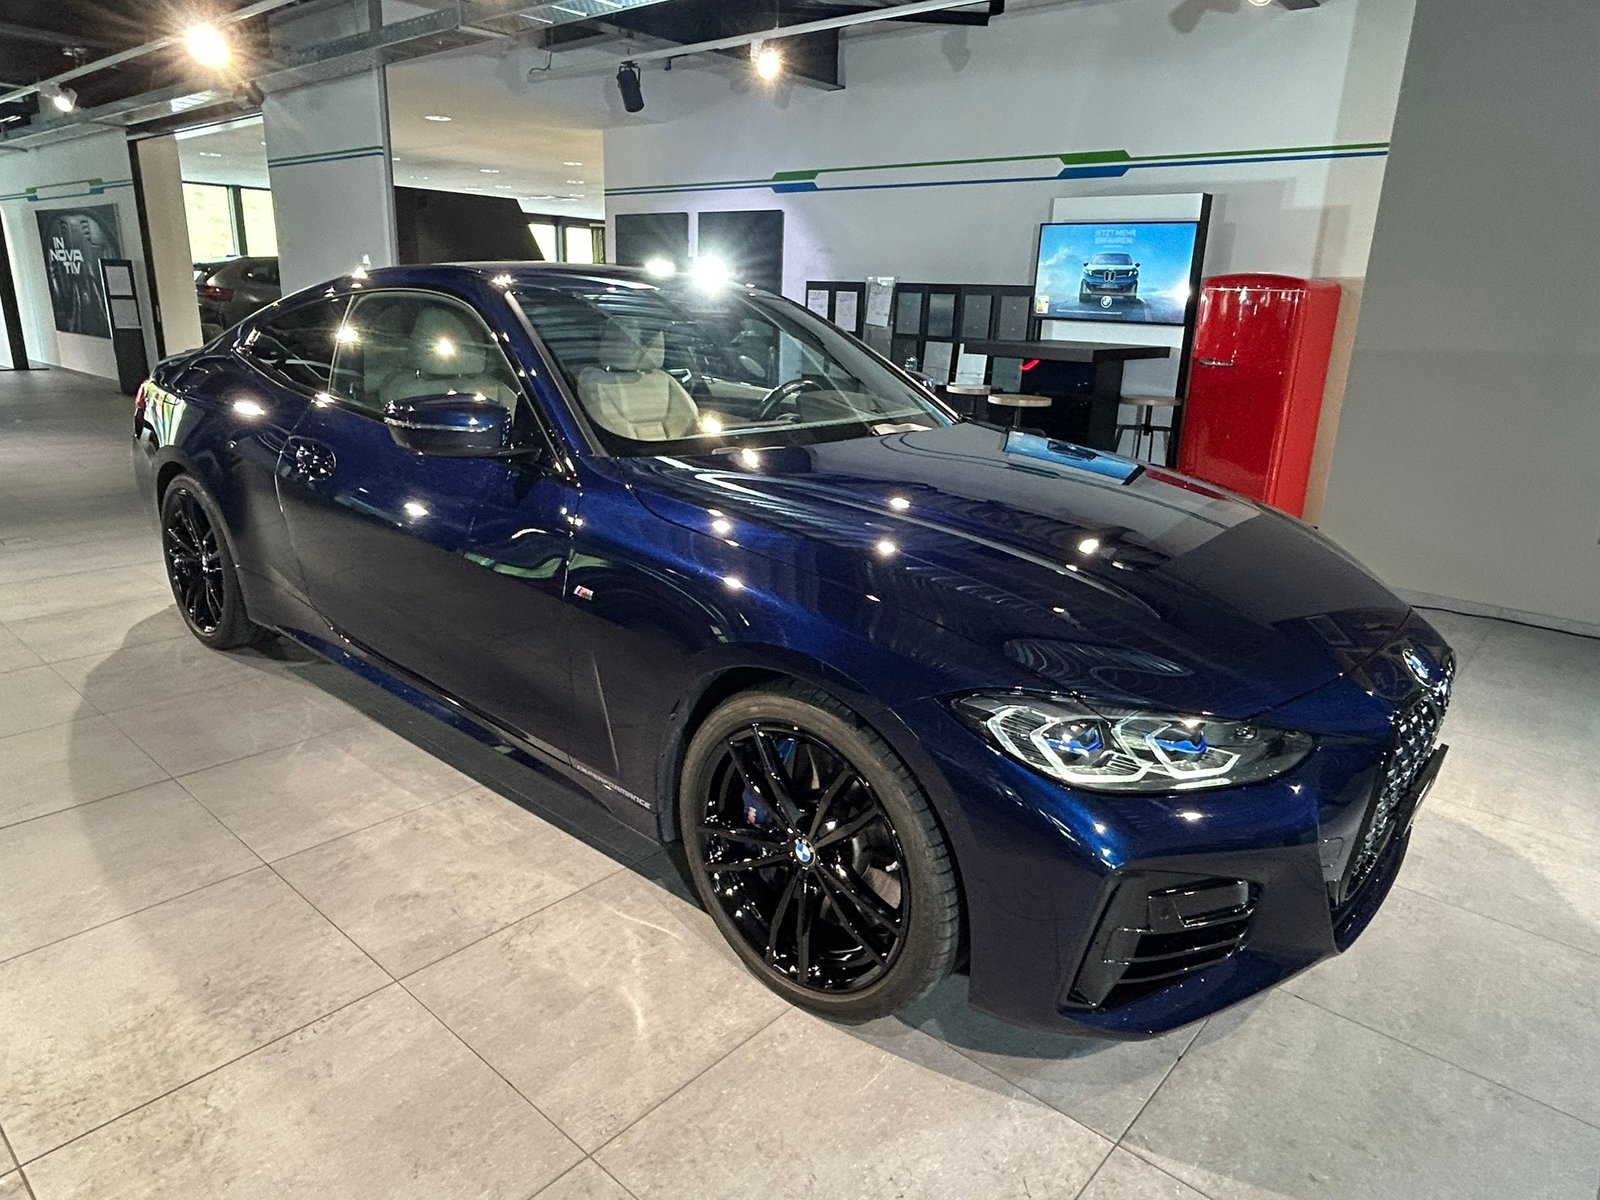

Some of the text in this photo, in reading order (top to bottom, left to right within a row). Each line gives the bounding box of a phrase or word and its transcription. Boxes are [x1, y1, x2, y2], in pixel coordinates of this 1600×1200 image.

[53, 237, 64, 248] IN
[50, 249, 83, 261] NOVA
[63, 262, 80, 273] TIV
